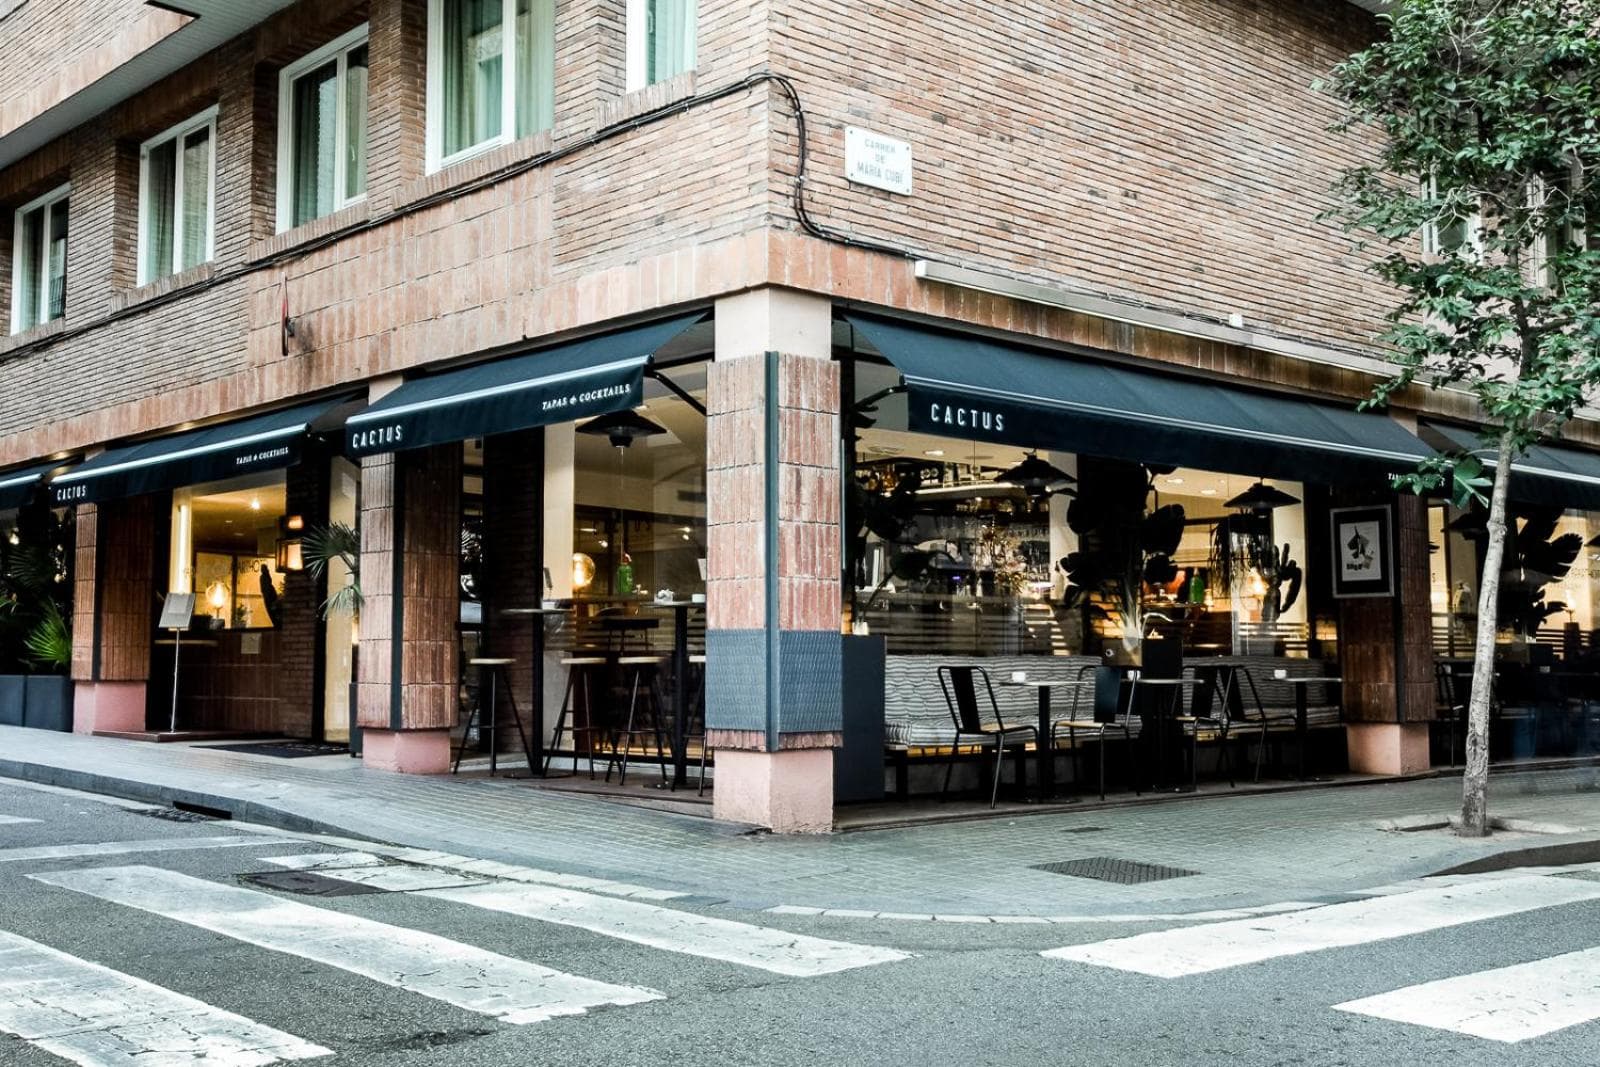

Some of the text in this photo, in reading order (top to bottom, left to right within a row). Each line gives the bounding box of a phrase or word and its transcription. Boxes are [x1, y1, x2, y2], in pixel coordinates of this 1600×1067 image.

[542, 397, 568, 410] TAPAS
[579, 383, 631, 403] COCKTAILS
[930, 403, 1004, 432] CACTUS
[352, 424, 402, 449] CACTUS
[57, 485, 86, 501] CACTUS
